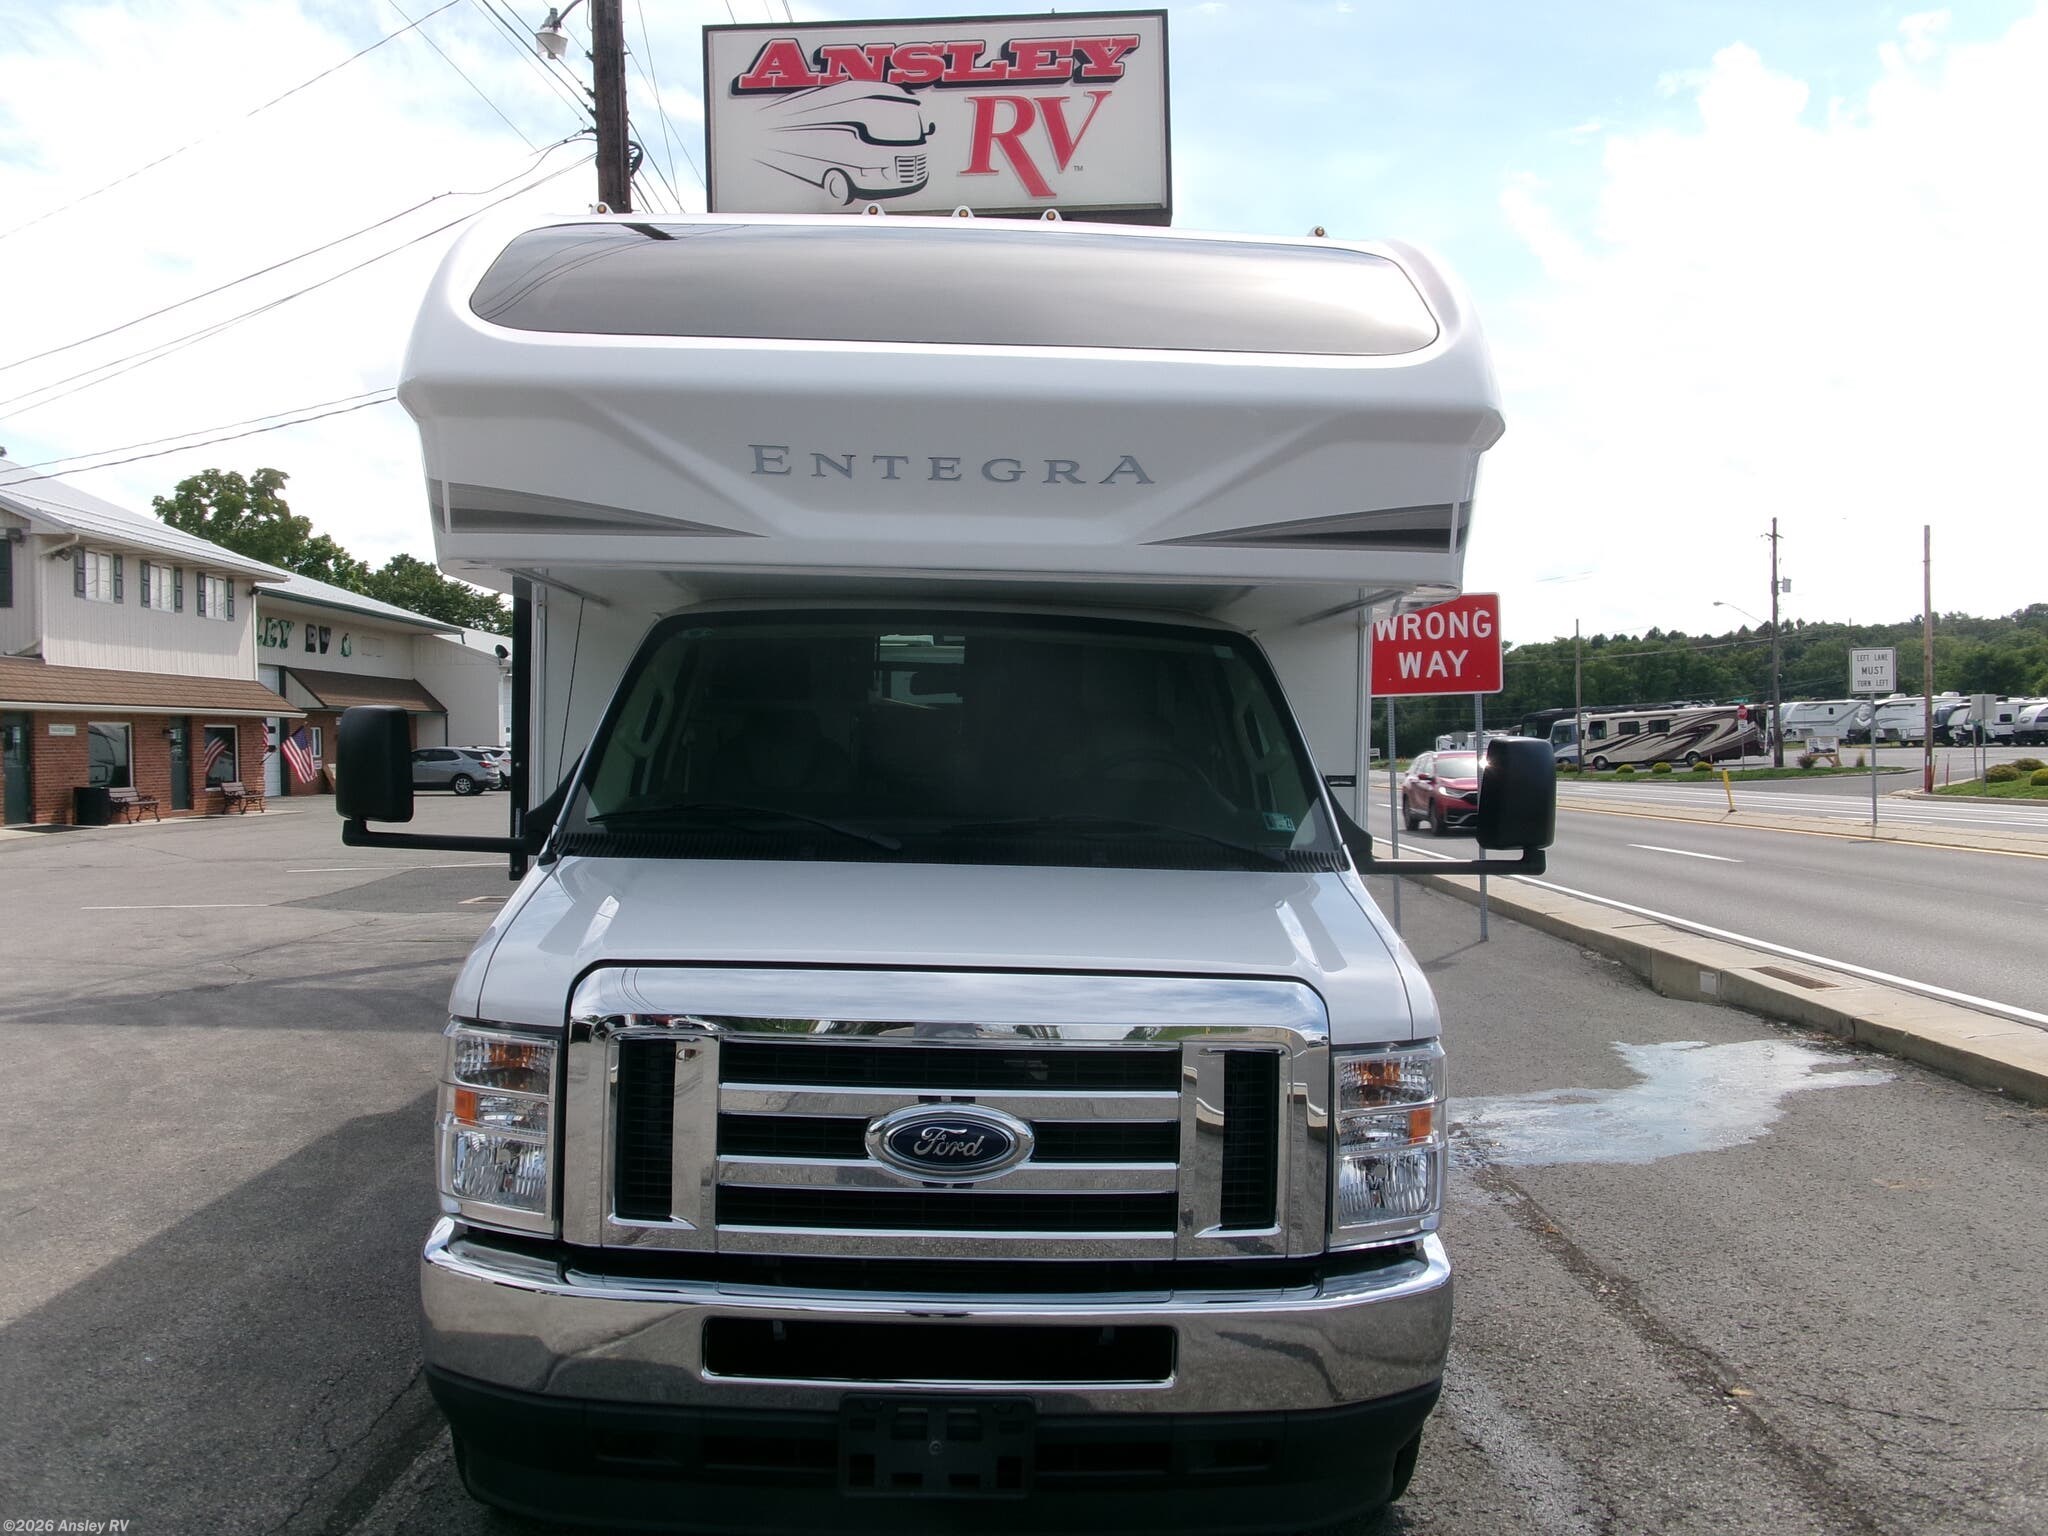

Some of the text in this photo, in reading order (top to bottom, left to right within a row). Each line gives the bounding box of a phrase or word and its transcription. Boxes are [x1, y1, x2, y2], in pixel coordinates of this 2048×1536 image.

[733, 34, 1140, 94] ANSLEY
[959, 91, 1113, 199] RV
[747, 444, 1156, 485] ENTEGRA
[304, 623, 332, 654] RV
[1375, 609, 1492, 642] WRONG
[1398, 650, 1469, 679] WAY
[1856, 653, 1889, 662] LEFT LANE
[1861, 666, 1884, 675] MUST
[1875, 679, 1889, 687] LEFT
[913, 1126, 985, 1156] Ford
